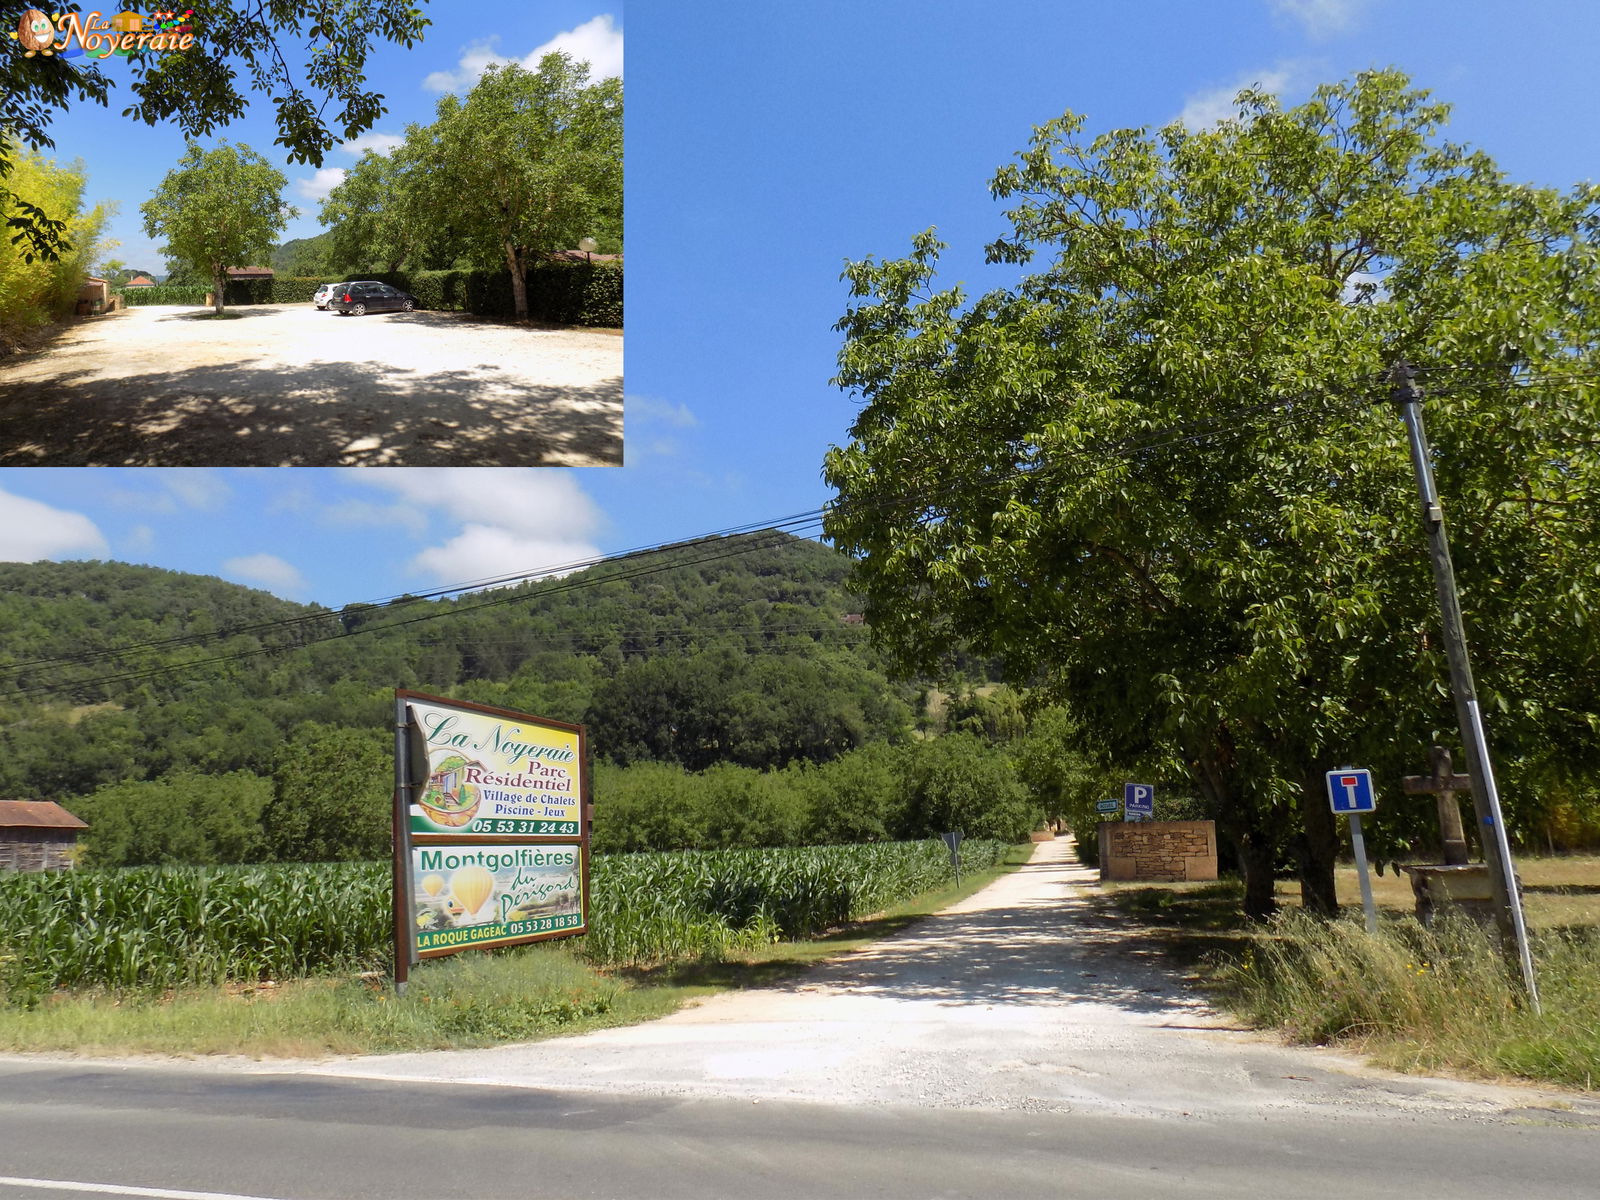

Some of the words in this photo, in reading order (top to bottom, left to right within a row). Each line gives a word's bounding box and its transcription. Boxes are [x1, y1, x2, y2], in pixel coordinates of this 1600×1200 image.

[424, 712, 471, 748] La
[473, 724, 575, 764] Noyeraie
[465, 768, 571, 792] Résidentiel
[528, 761, 566, 778] Parc
[484, 790, 522, 805] Village
[525, 793, 538, 804] de
[540, 795, 576, 806] Chalets
[1134, 786, 1147, 804] P
[495, 804, 534, 816] Piscine
[544, 808, 566, 817] Jeux
[472, 820, 492, 833] 05
[496, 821, 515, 833] 53
[518, 821, 534, 833] 31
[538, 822, 556, 833] 24
[559, 823, 575, 834] 43
[421, 849, 574, 873] Montgolfières
[511, 867, 536, 891] du
[500, 876, 574, 922] Périgord
[417, 935, 431, 948] LA
[433, 930, 469, 946] ROQUE
[470, 925, 507, 941] GAGEAC
[510, 922, 524, 934] 05
[526, 920, 538, 932] 53
[540, 918, 552, 930] 28
[555, 917, 565, 928] 18
[567, 916, 578, 927] 58
